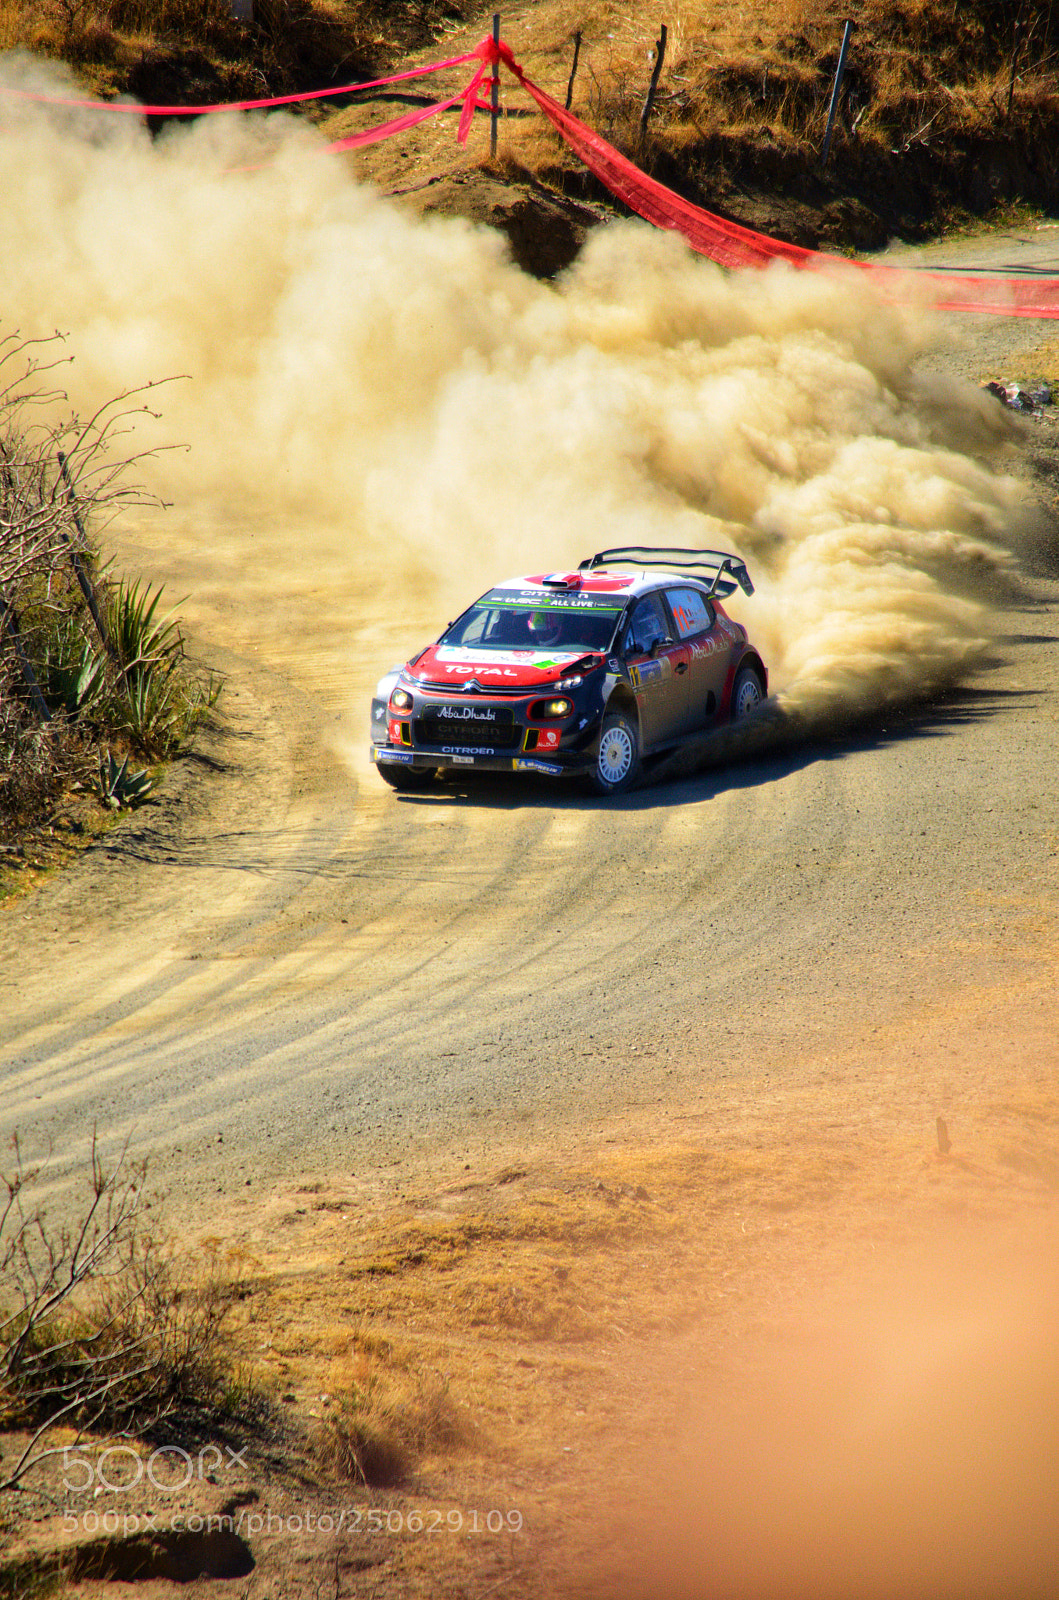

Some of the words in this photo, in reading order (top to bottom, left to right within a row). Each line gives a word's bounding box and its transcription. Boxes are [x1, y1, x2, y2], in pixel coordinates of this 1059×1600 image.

[550, 599, 569, 607] ALL
[673, 605, 690, 632] 11
[445, 665, 518, 677] TOTAL
[630, 666, 641, 687] 11
